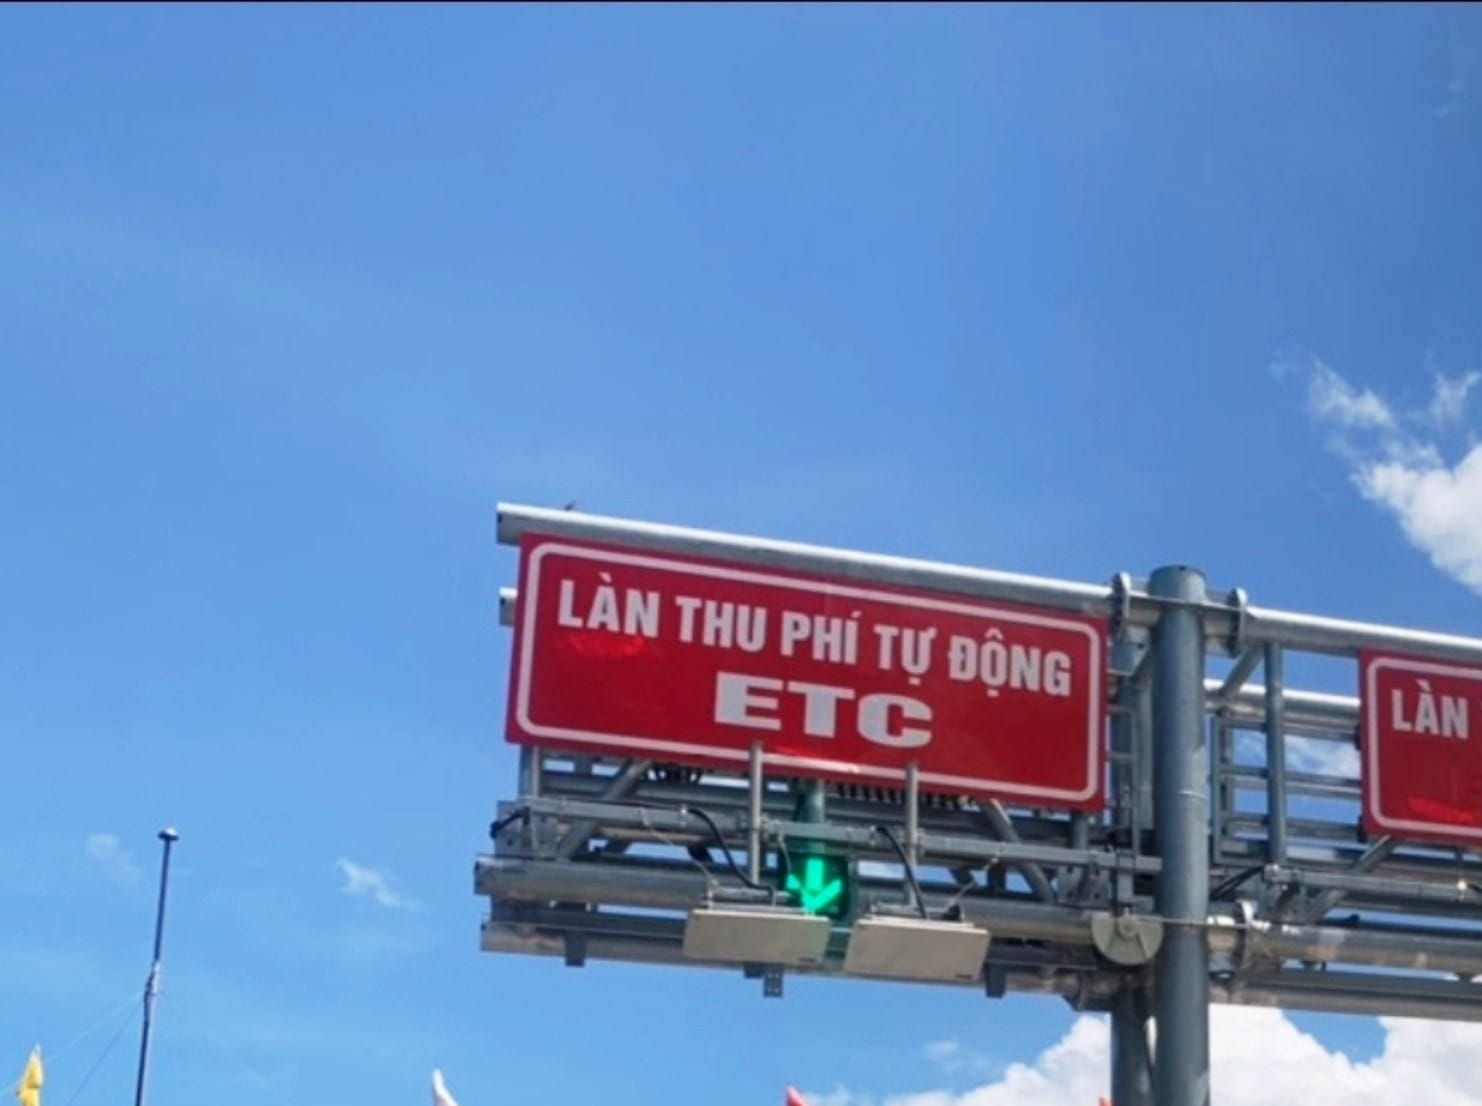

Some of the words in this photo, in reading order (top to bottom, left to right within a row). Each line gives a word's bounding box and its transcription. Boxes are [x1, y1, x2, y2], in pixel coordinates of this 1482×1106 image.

[557, 573, 661, 638] LÀN
[675, 596, 767, 654] THU
[780, 610, 861, 665] PHÍ
[874, 625, 939, 685] TỰ
[948, 628, 1073, 698] ĐỘNG
[714, 671, 933, 749] ETC
[1391, 679, 1469, 739] LÀN
